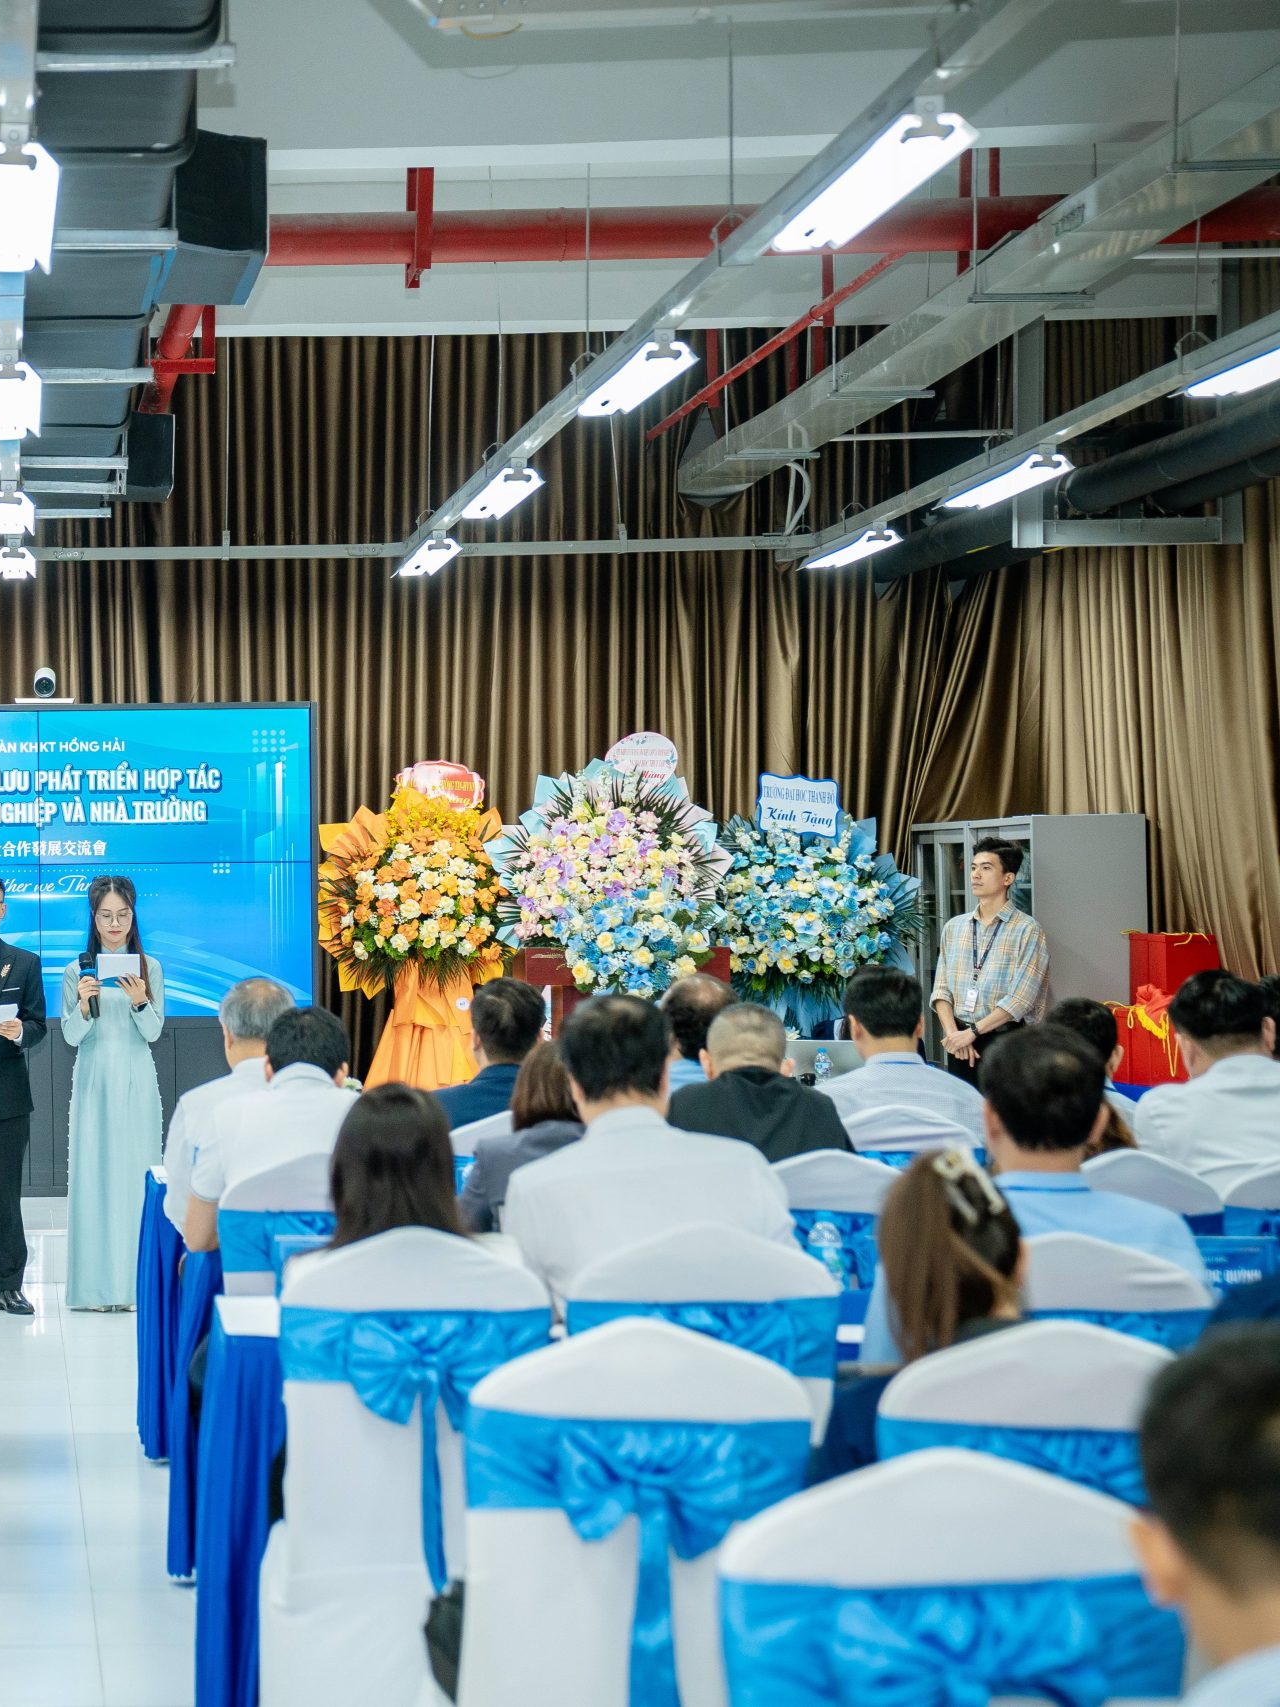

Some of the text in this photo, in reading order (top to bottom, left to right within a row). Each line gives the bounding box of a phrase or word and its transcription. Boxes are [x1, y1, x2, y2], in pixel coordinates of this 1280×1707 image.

[20, 742, 56, 753] KHKT
[59, 737, 99, 752] HỒNG
[102, 737, 125, 752] HẢI
[34, 763, 83, 792] PHÁT
[86, 760, 138, 791] TRIỂN
[143, 767, 182, 795] HỢP
[186, 762, 221, 790] TÁC
[61, 795, 86, 823] VÀ
[90, 795, 129, 823] NHÀ
[131, 793, 207, 823] TRƯỜNG
[764, 807, 834, 828] Kính Tặng
[4, 874, 93, 893] ther we Thr
